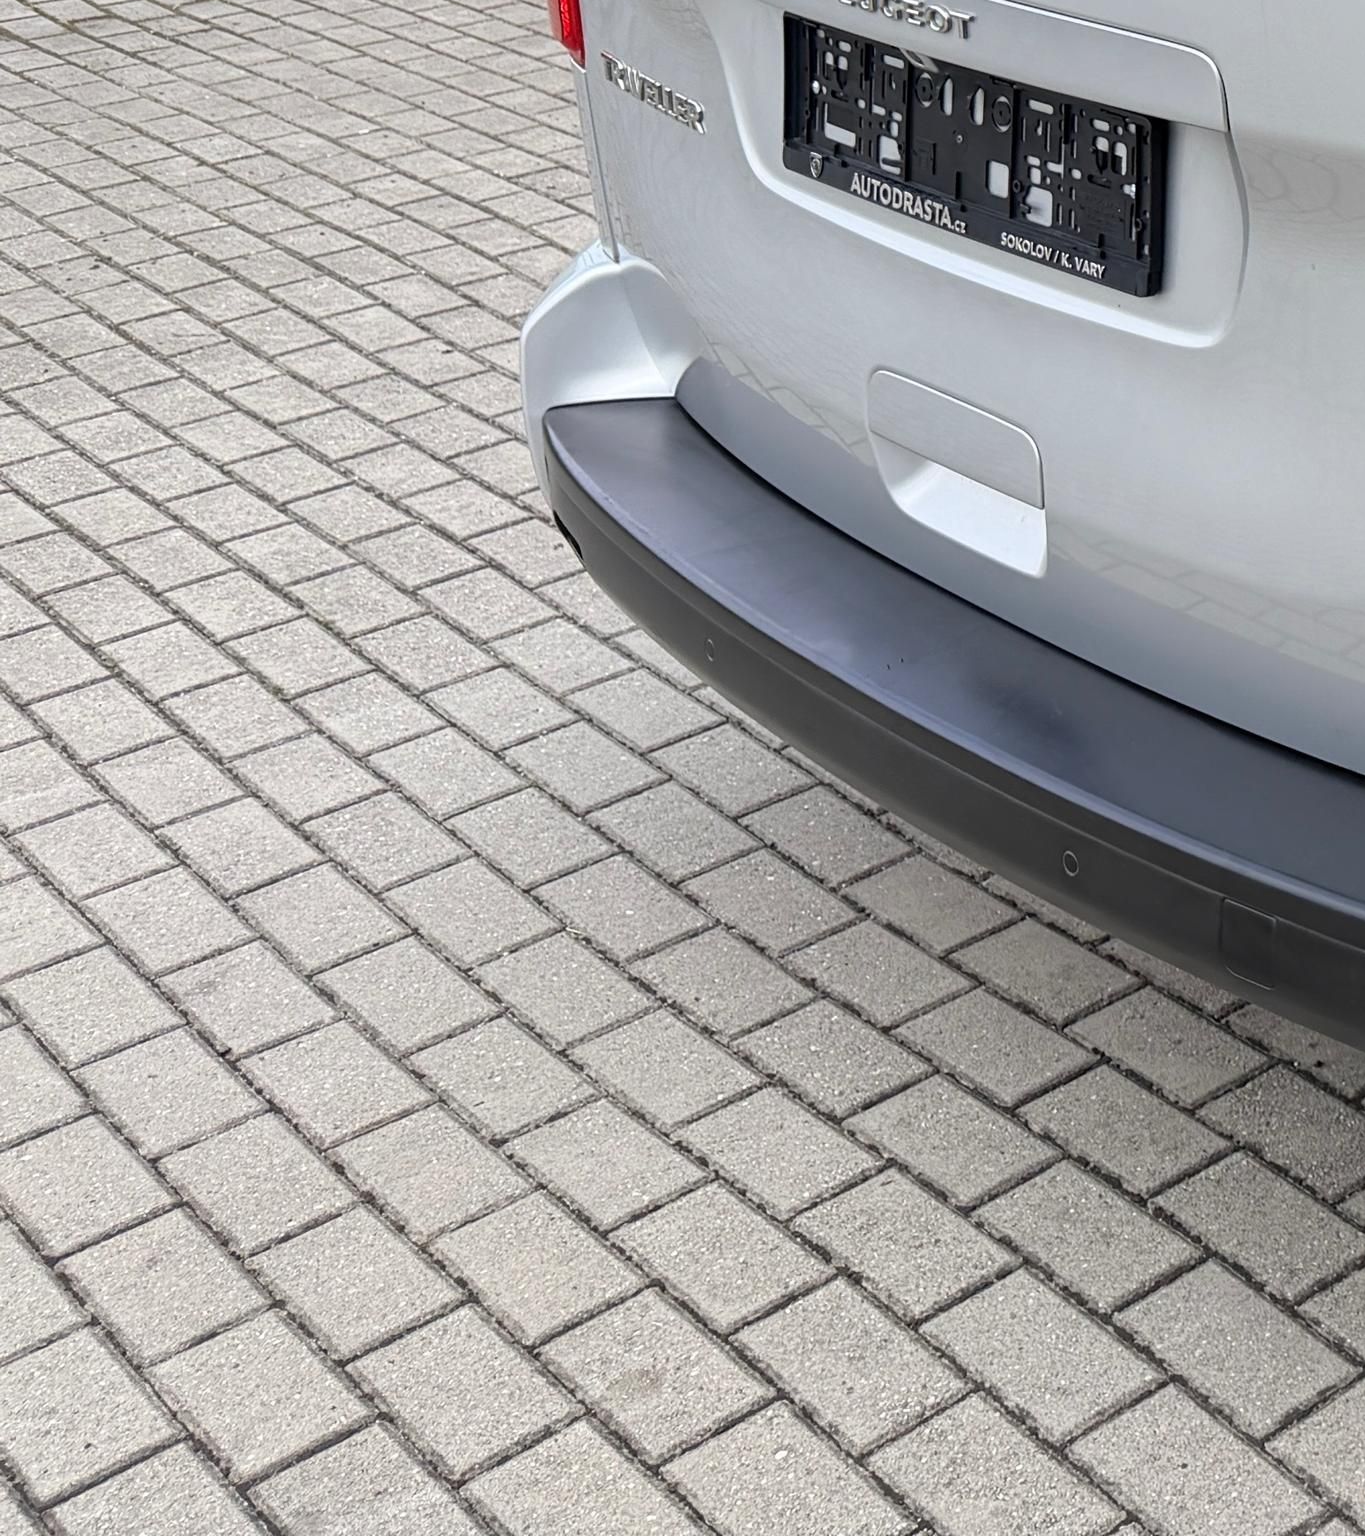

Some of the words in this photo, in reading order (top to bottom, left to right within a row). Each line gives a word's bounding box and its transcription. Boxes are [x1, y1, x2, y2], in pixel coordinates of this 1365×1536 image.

[600, 50, 706, 135] TRAVELLER
[850, 172, 967, 234] AUTODRASTA.cz
[1000, 231, 1053, 264] SOKOLOV
[1061, 252, 1073, 270] K.
[1073, 258, 1105, 280] VARY
